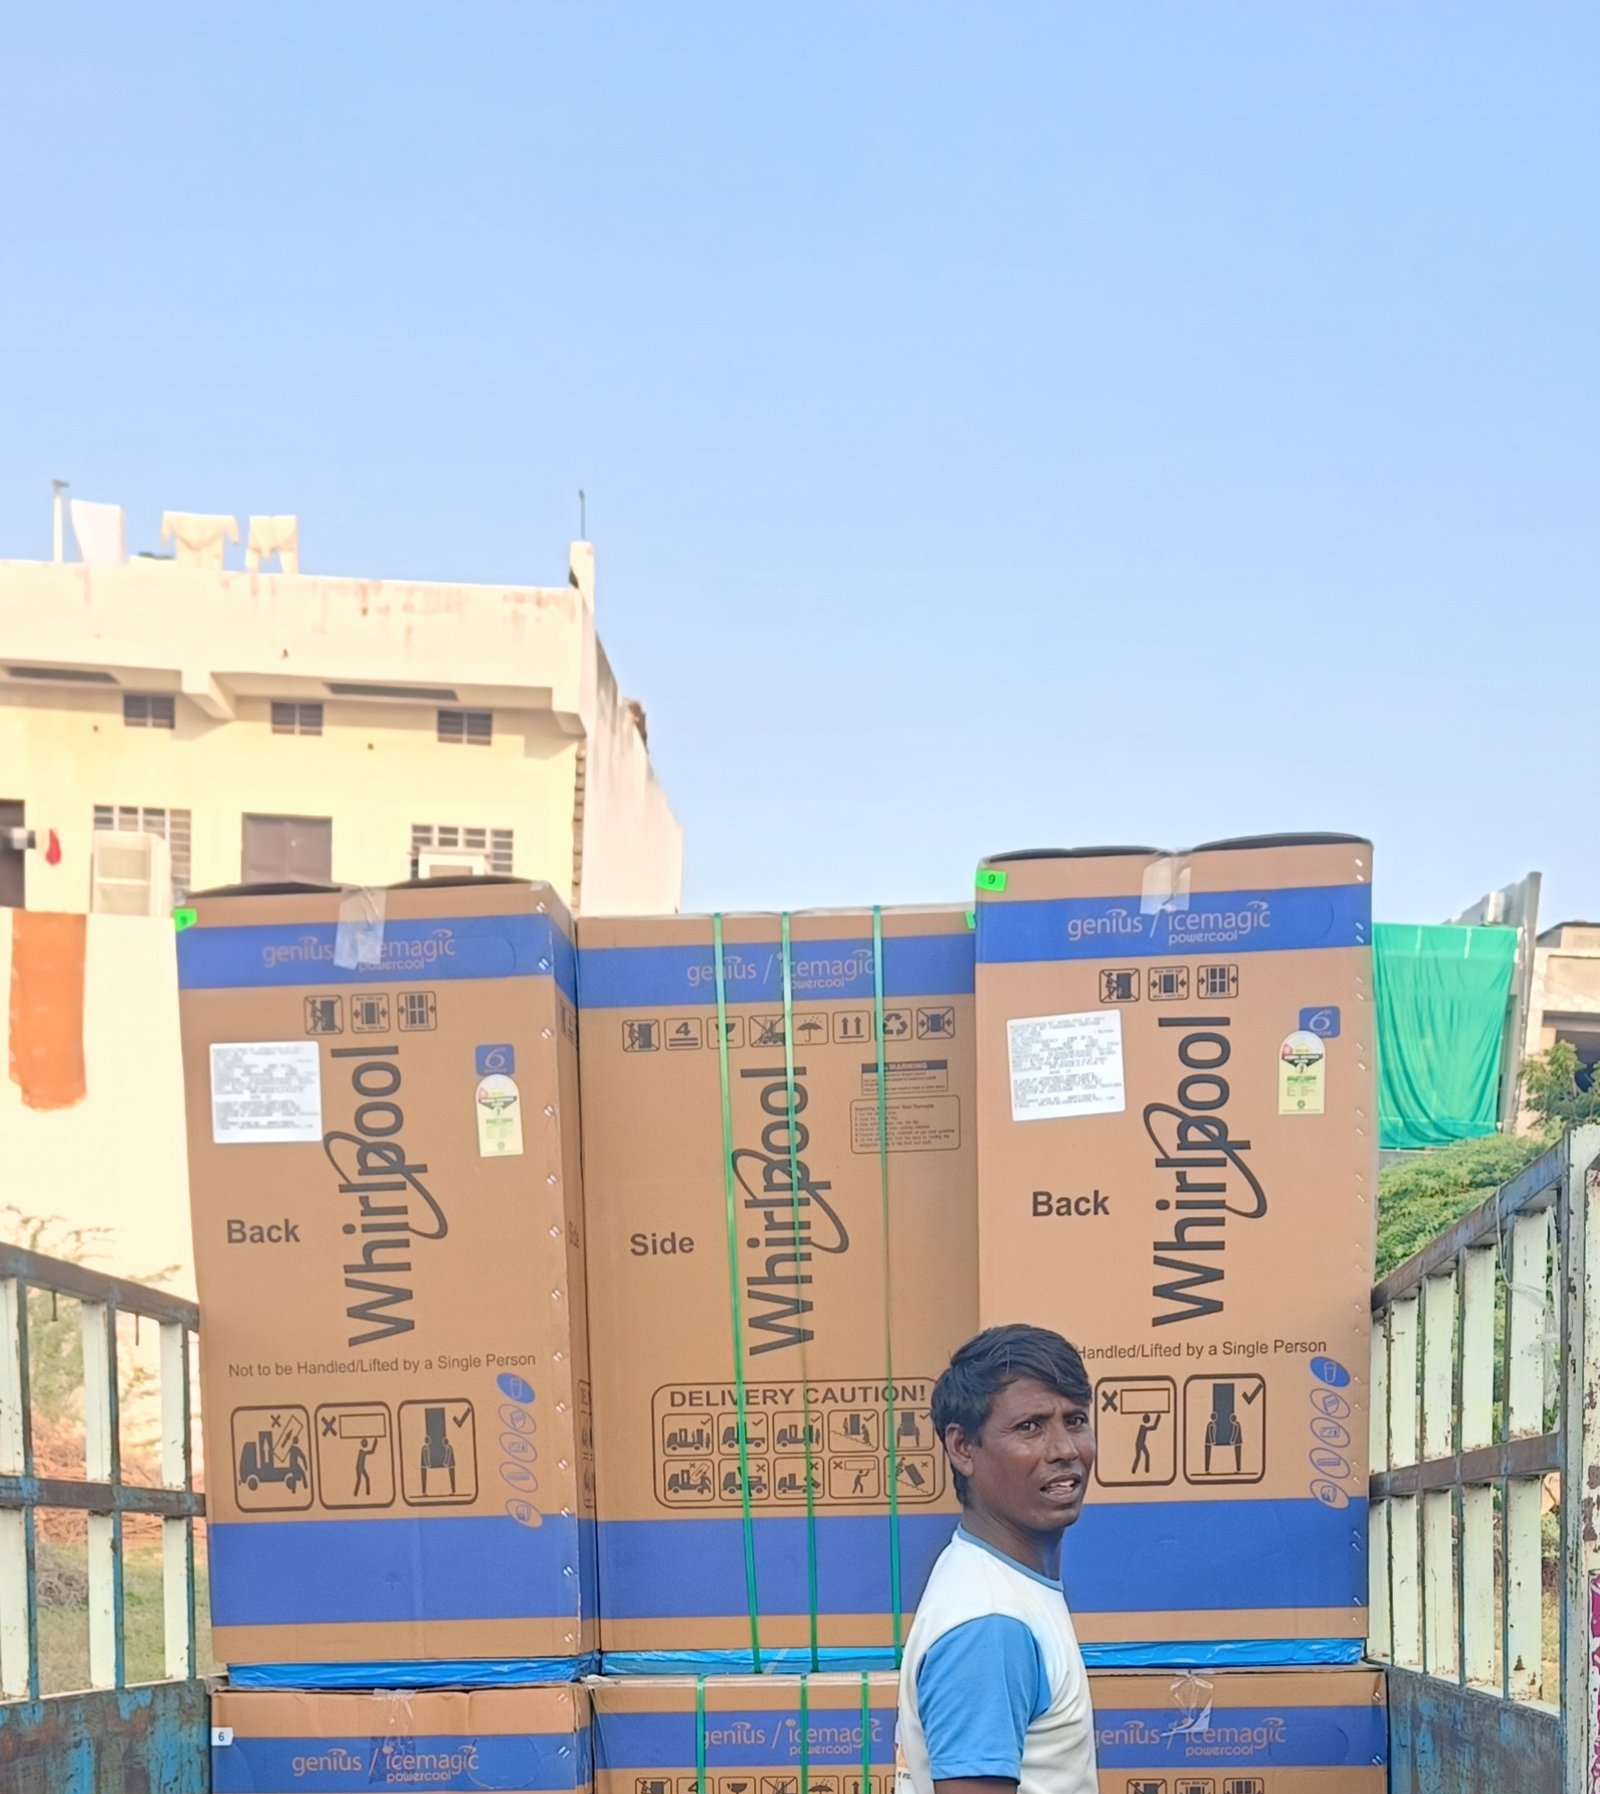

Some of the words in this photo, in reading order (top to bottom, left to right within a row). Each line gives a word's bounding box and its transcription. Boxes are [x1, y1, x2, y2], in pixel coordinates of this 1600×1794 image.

[988, 874, 996, 885] 9
[1067, 908, 1144, 942] genius
[1168, 900, 1271, 934] icemagic
[262, 936, 334, 968] genius
[373, 929, 456, 962] emagic
[1168, 930, 1238, 946] powercool
[687, 956, 757, 987] geius
[790, 976, 845, 990] owercool
[1151, 1016, 1251, 1328] Whirlpool
[330, 1045, 428, 1348] Whirlpool
[1031, 1189, 1111, 1217] Back
[739, 1066, 832, 1357] Whirlpool
[226, 1218, 301, 1245] Back
[629, 1232, 695, 1257] Side
[1078, 1342, 1182, 1360] Handled/Lifted
[1186, 1342, 1203, 1359] by
[1209, 1345, 1218, 1356] a
[1222, 1340, 1269, 1359] Single
[1273, 1338, 1327, 1355] Person
[228, 1362, 253, 1377] Not
[257, 1363, 271, 1376] to
[275, 1361, 293, 1375] be
[297, 1358, 399, 1375] Handled/Lifted
[403, 1357, 420, 1374] by
[424, 1359, 433, 1371] a
[437, 1354, 482, 1372] Single
[486, 1352, 536, 1369] Person
[803, 1384, 926, 1404] CAUTION!
[218, 1732, 226, 1742] 6
[789, 1718, 883, 1748] icemagc
[1185, 1717, 1287, 1749] icemagic
[291, 1748, 362, 1776] genius
[385, 1745, 479, 1775] icemagic
[1185, 1744, 1254, 1757] powercool
[386, 1769, 452, 1783] powercool
